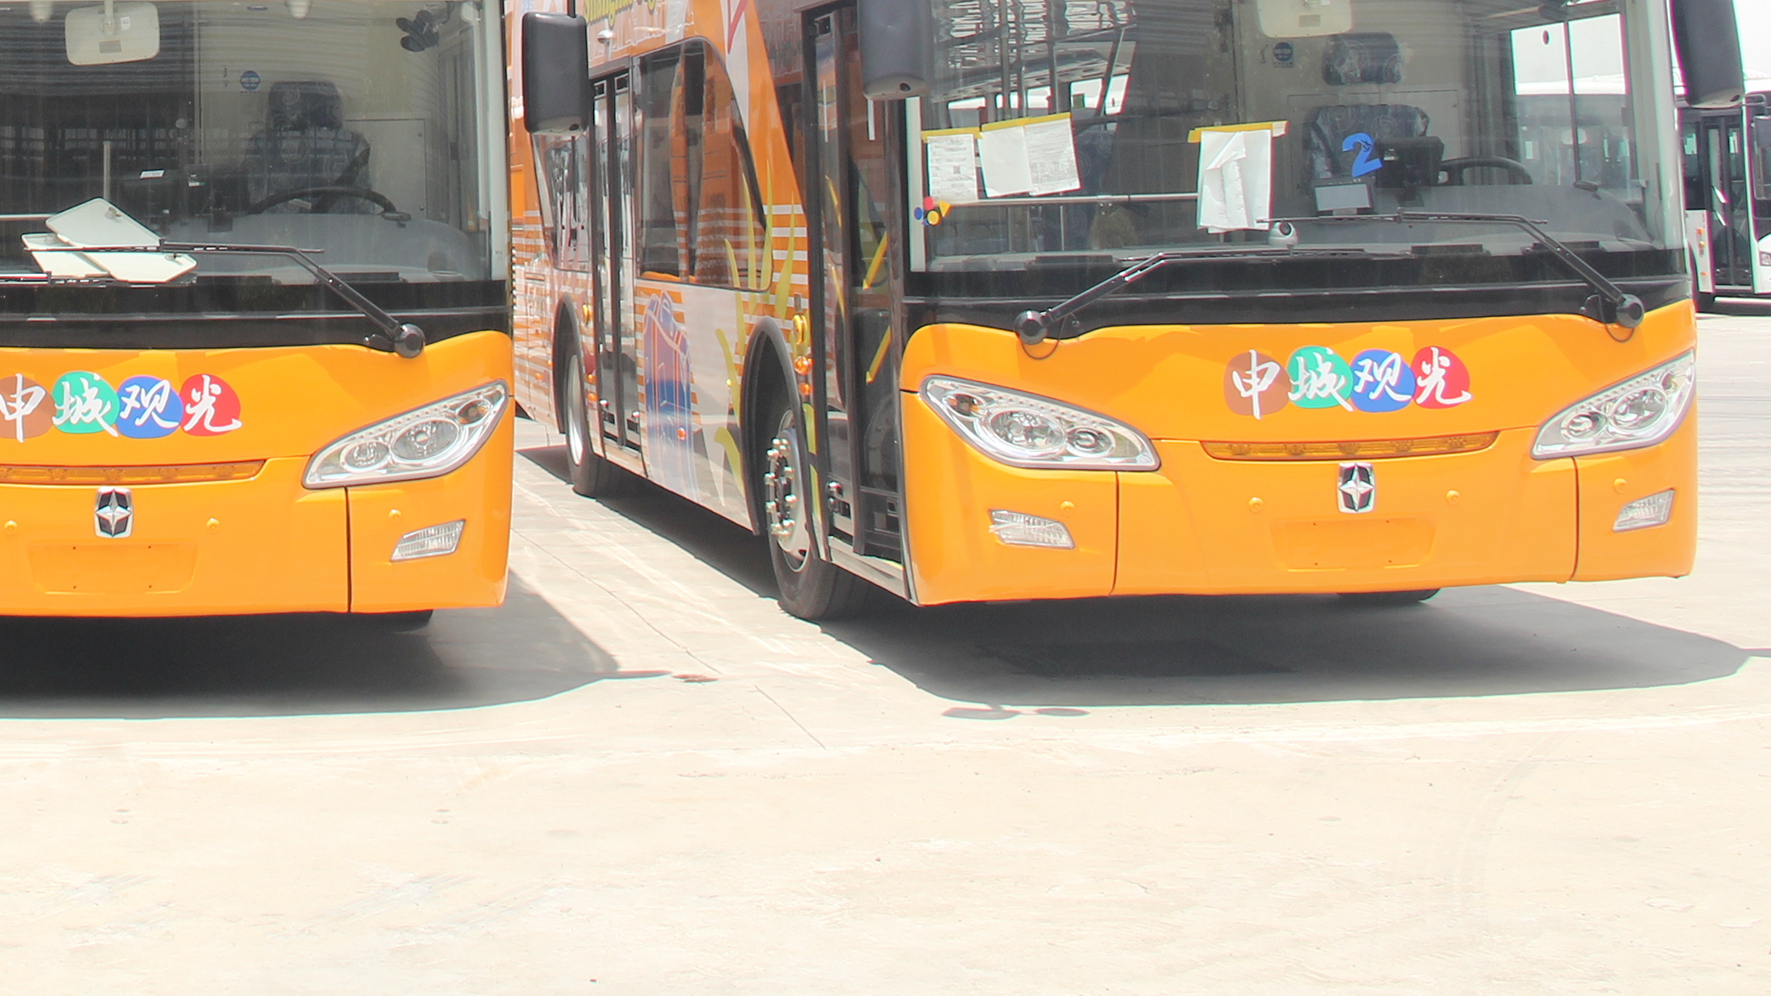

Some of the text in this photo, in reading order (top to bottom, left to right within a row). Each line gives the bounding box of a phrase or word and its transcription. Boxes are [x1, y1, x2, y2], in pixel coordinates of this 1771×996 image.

[1342, 132, 1383, 178] 2
[1232, 347, 1473, 420] 申城观光
